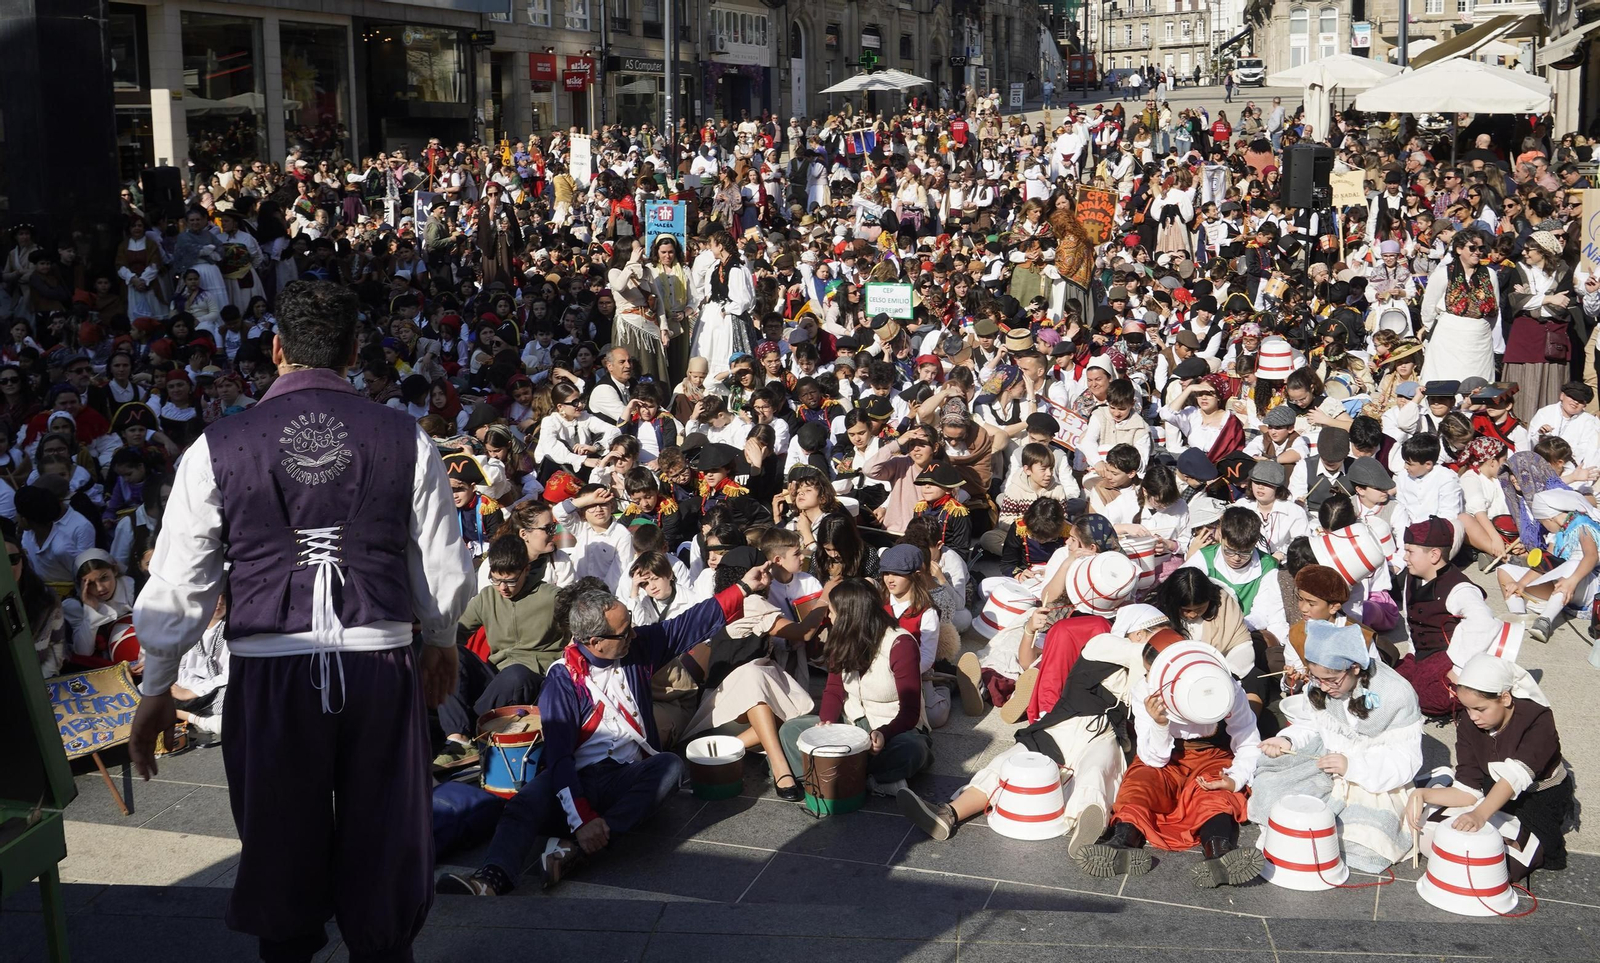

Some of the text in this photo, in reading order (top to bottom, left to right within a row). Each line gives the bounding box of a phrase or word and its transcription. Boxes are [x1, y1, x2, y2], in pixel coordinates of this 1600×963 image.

[625, 60, 663, 71] AS Computer
[1086, 191, 1109, 202] CPR
[869, 296, 910, 305] CELSO EMILIO
[874, 306, 904, 314] FERREIRO
[1327, 323, 1338, 332] N
[124, 409, 145, 424] N
[447, 460, 469, 475] N
[923, 463, 940, 474] N
[1226, 462, 1243, 478] N
